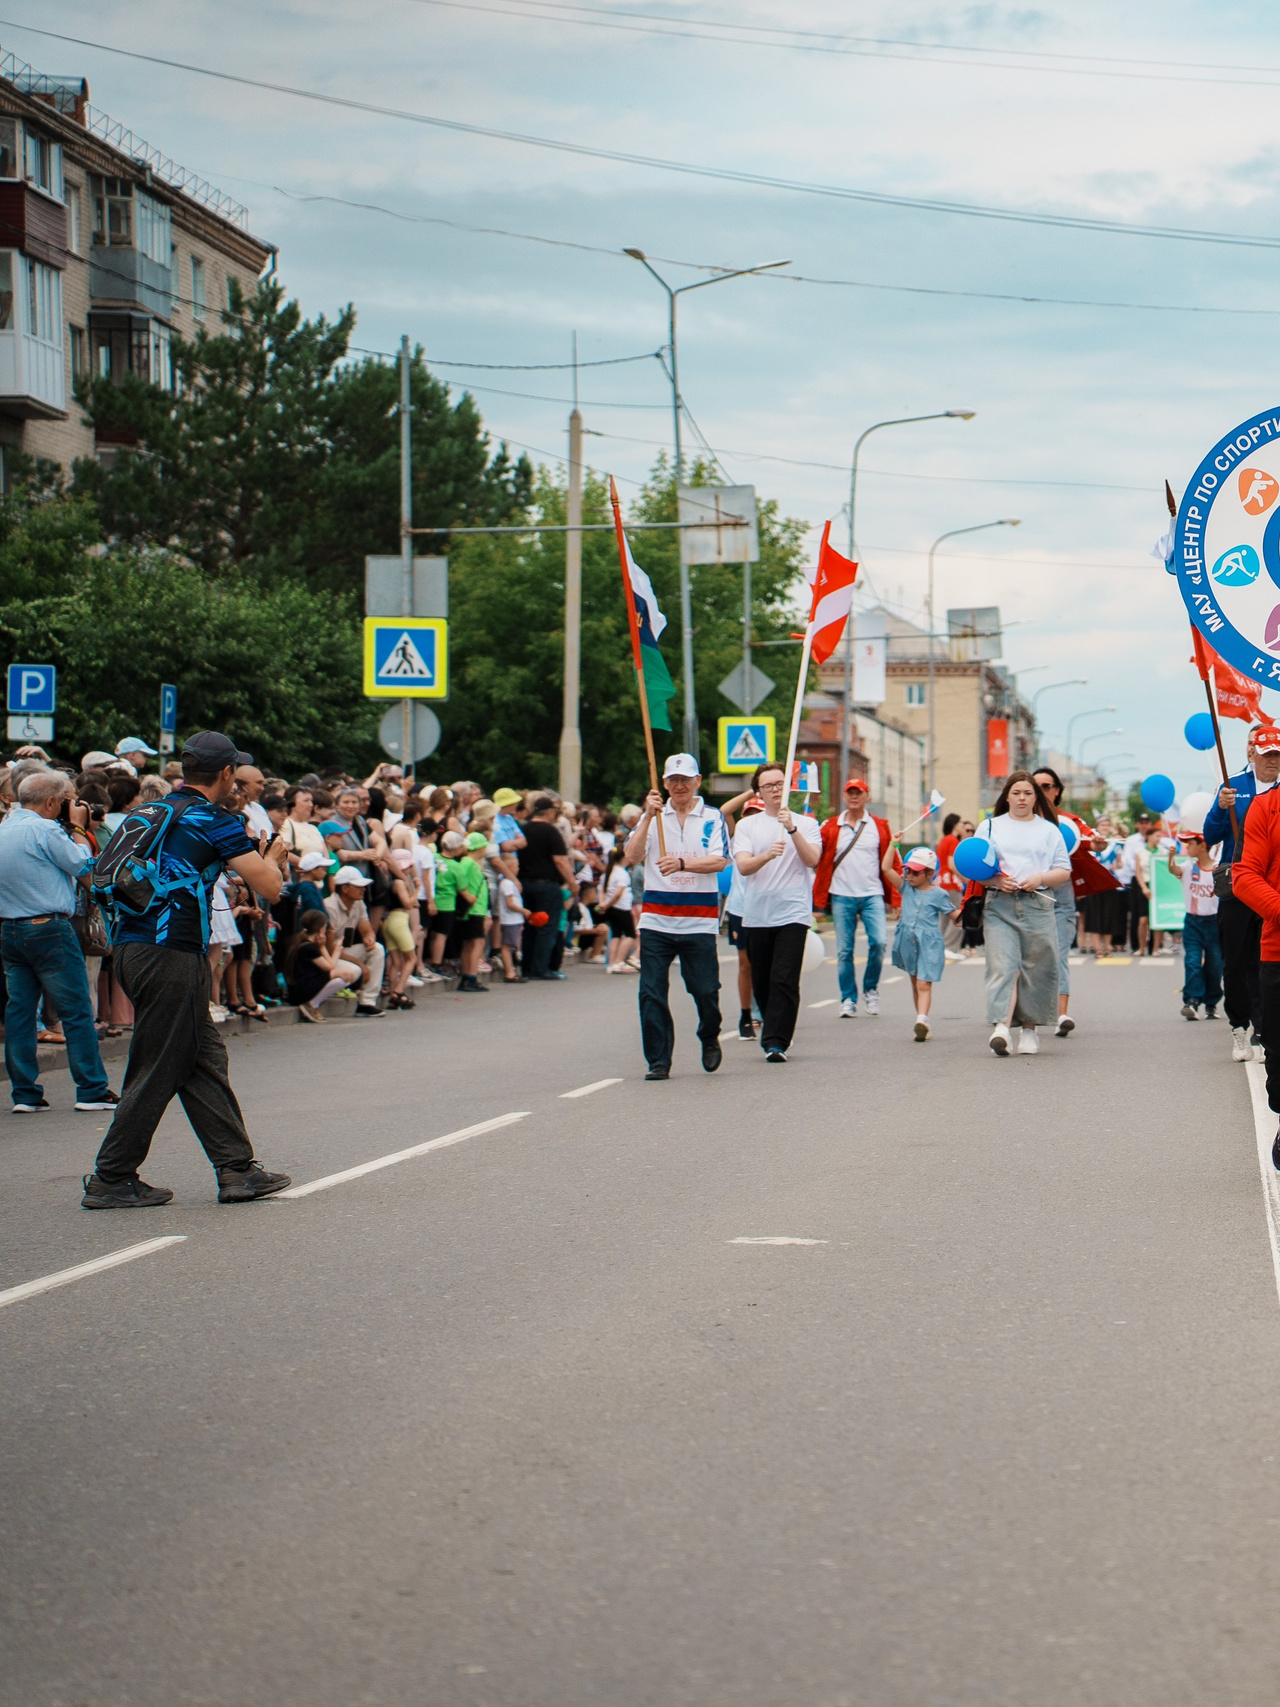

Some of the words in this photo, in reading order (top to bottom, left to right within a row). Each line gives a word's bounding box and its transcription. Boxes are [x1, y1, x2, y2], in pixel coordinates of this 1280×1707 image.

[1193, 472, 1218, 503] ПО
[1183, 506, 1203, 585] «ЦЕНТР
[1192, 593, 1224, 633] МАУ
[1252, 656, 1265, 673] г.
[21, 671, 46, 706] P
[165, 690, 173, 725] P
[670, 876, 696, 886] SPORT
